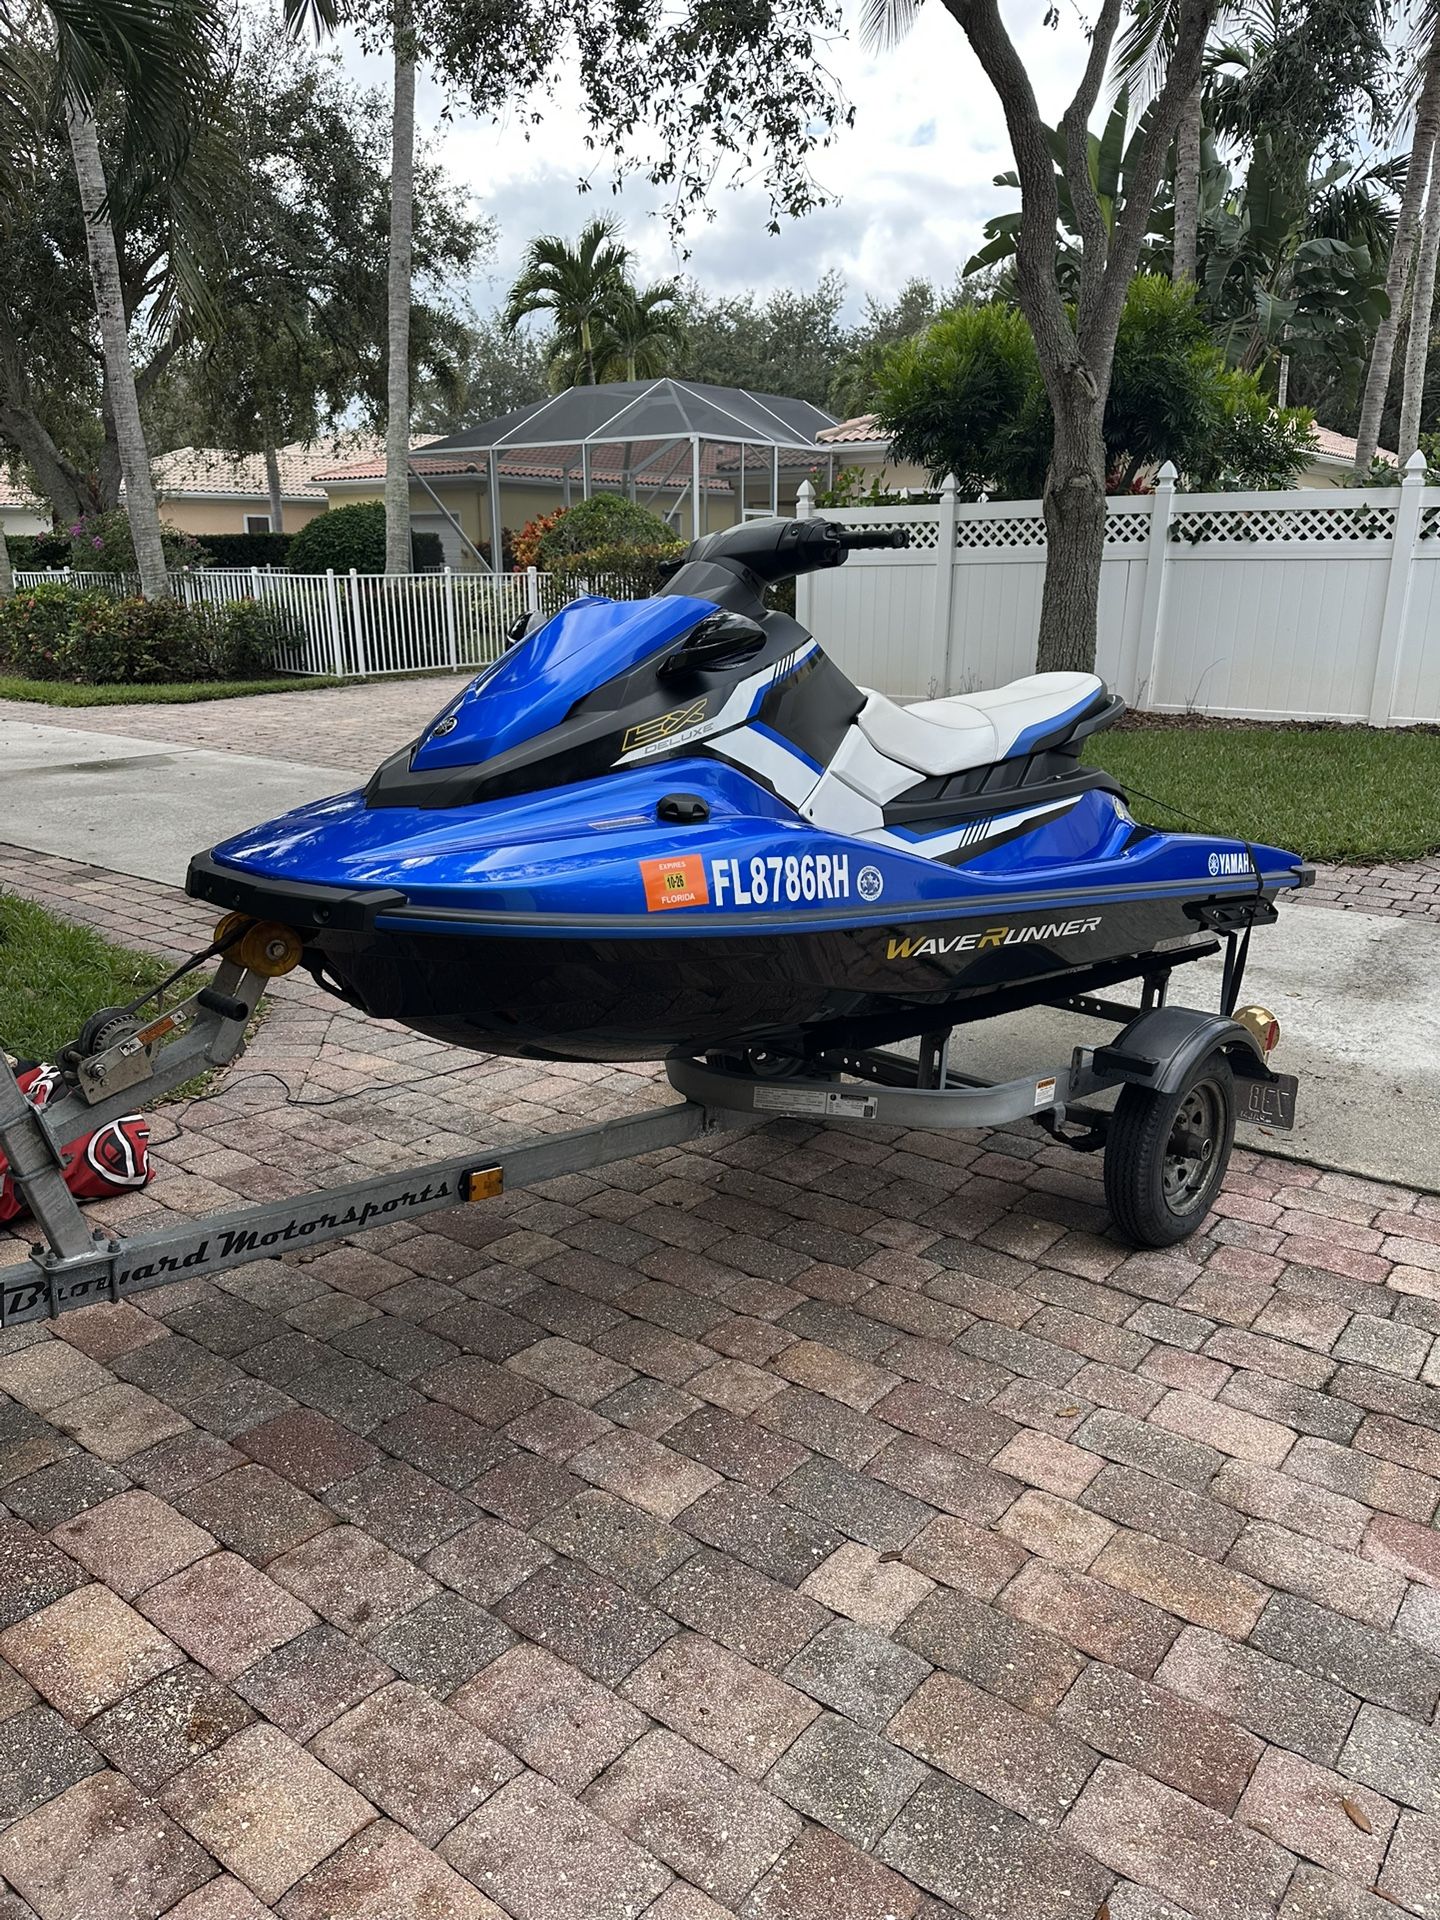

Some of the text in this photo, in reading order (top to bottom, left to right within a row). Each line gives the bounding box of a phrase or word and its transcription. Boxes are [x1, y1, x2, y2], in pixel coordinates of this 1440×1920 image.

[621, 698, 708, 752] EX
[644, 722, 714, 754] DELUXE
[658, 861, 687, 871] EXPIRES
[711, 853, 850, 907] FL8786RH
[661, 893, 696, 904] FLORIDA
[217, 1181, 453, 1258] Motorsports
